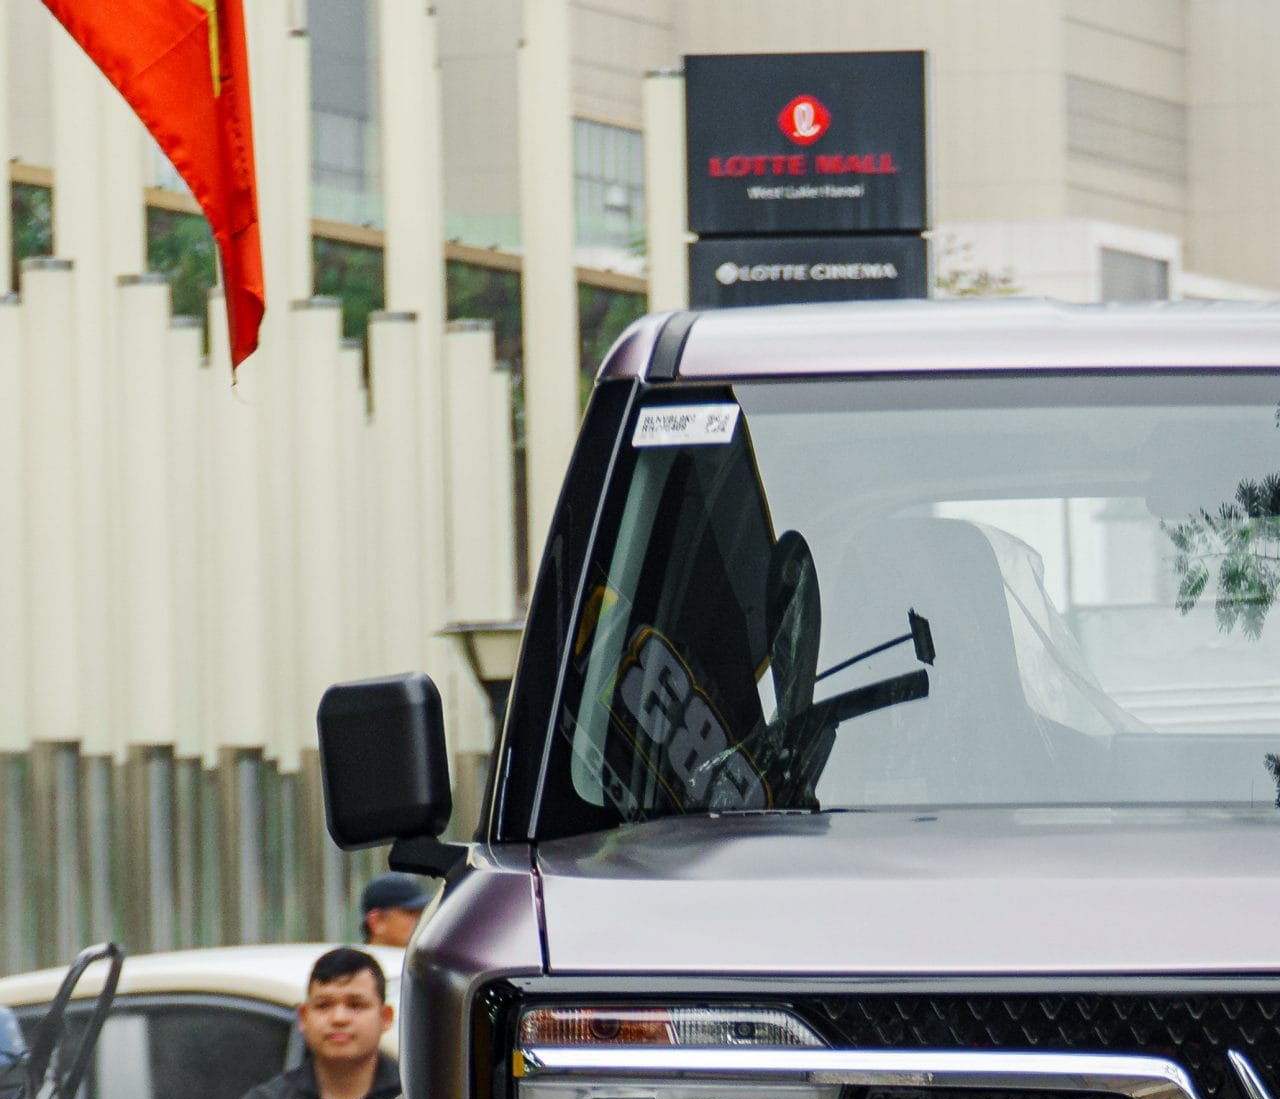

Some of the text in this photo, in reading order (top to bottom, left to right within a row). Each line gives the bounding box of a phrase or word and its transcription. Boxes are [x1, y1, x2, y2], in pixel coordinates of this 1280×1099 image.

[708, 153, 896, 178] LOTTE MALL
[739, 262, 899, 282] LOTTE CINEMA
